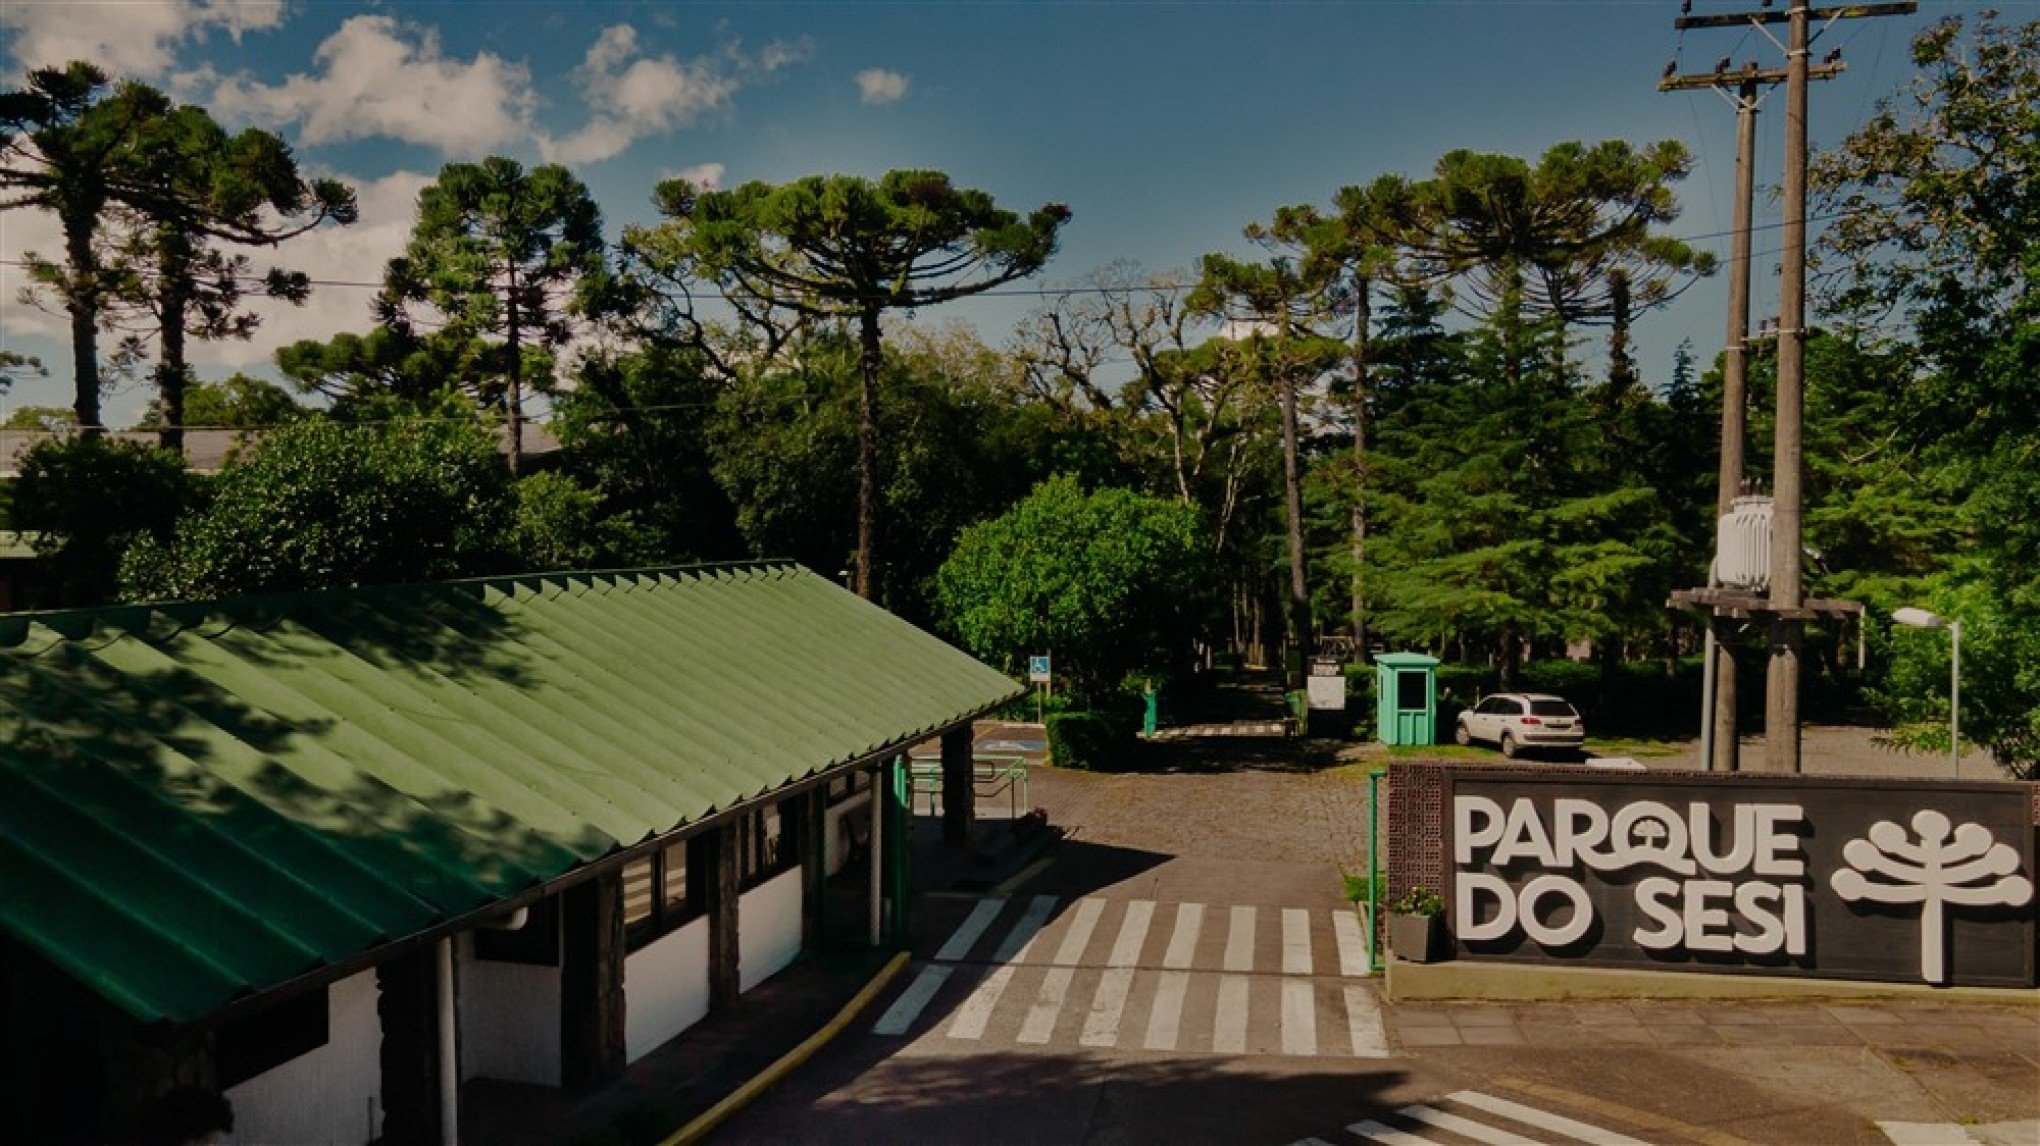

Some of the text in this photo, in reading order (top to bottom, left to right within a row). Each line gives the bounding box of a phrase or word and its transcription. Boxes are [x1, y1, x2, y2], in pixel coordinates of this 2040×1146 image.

[1455, 796, 1804, 876] PARQUE
[1456, 872, 1806, 955] DO SESI
